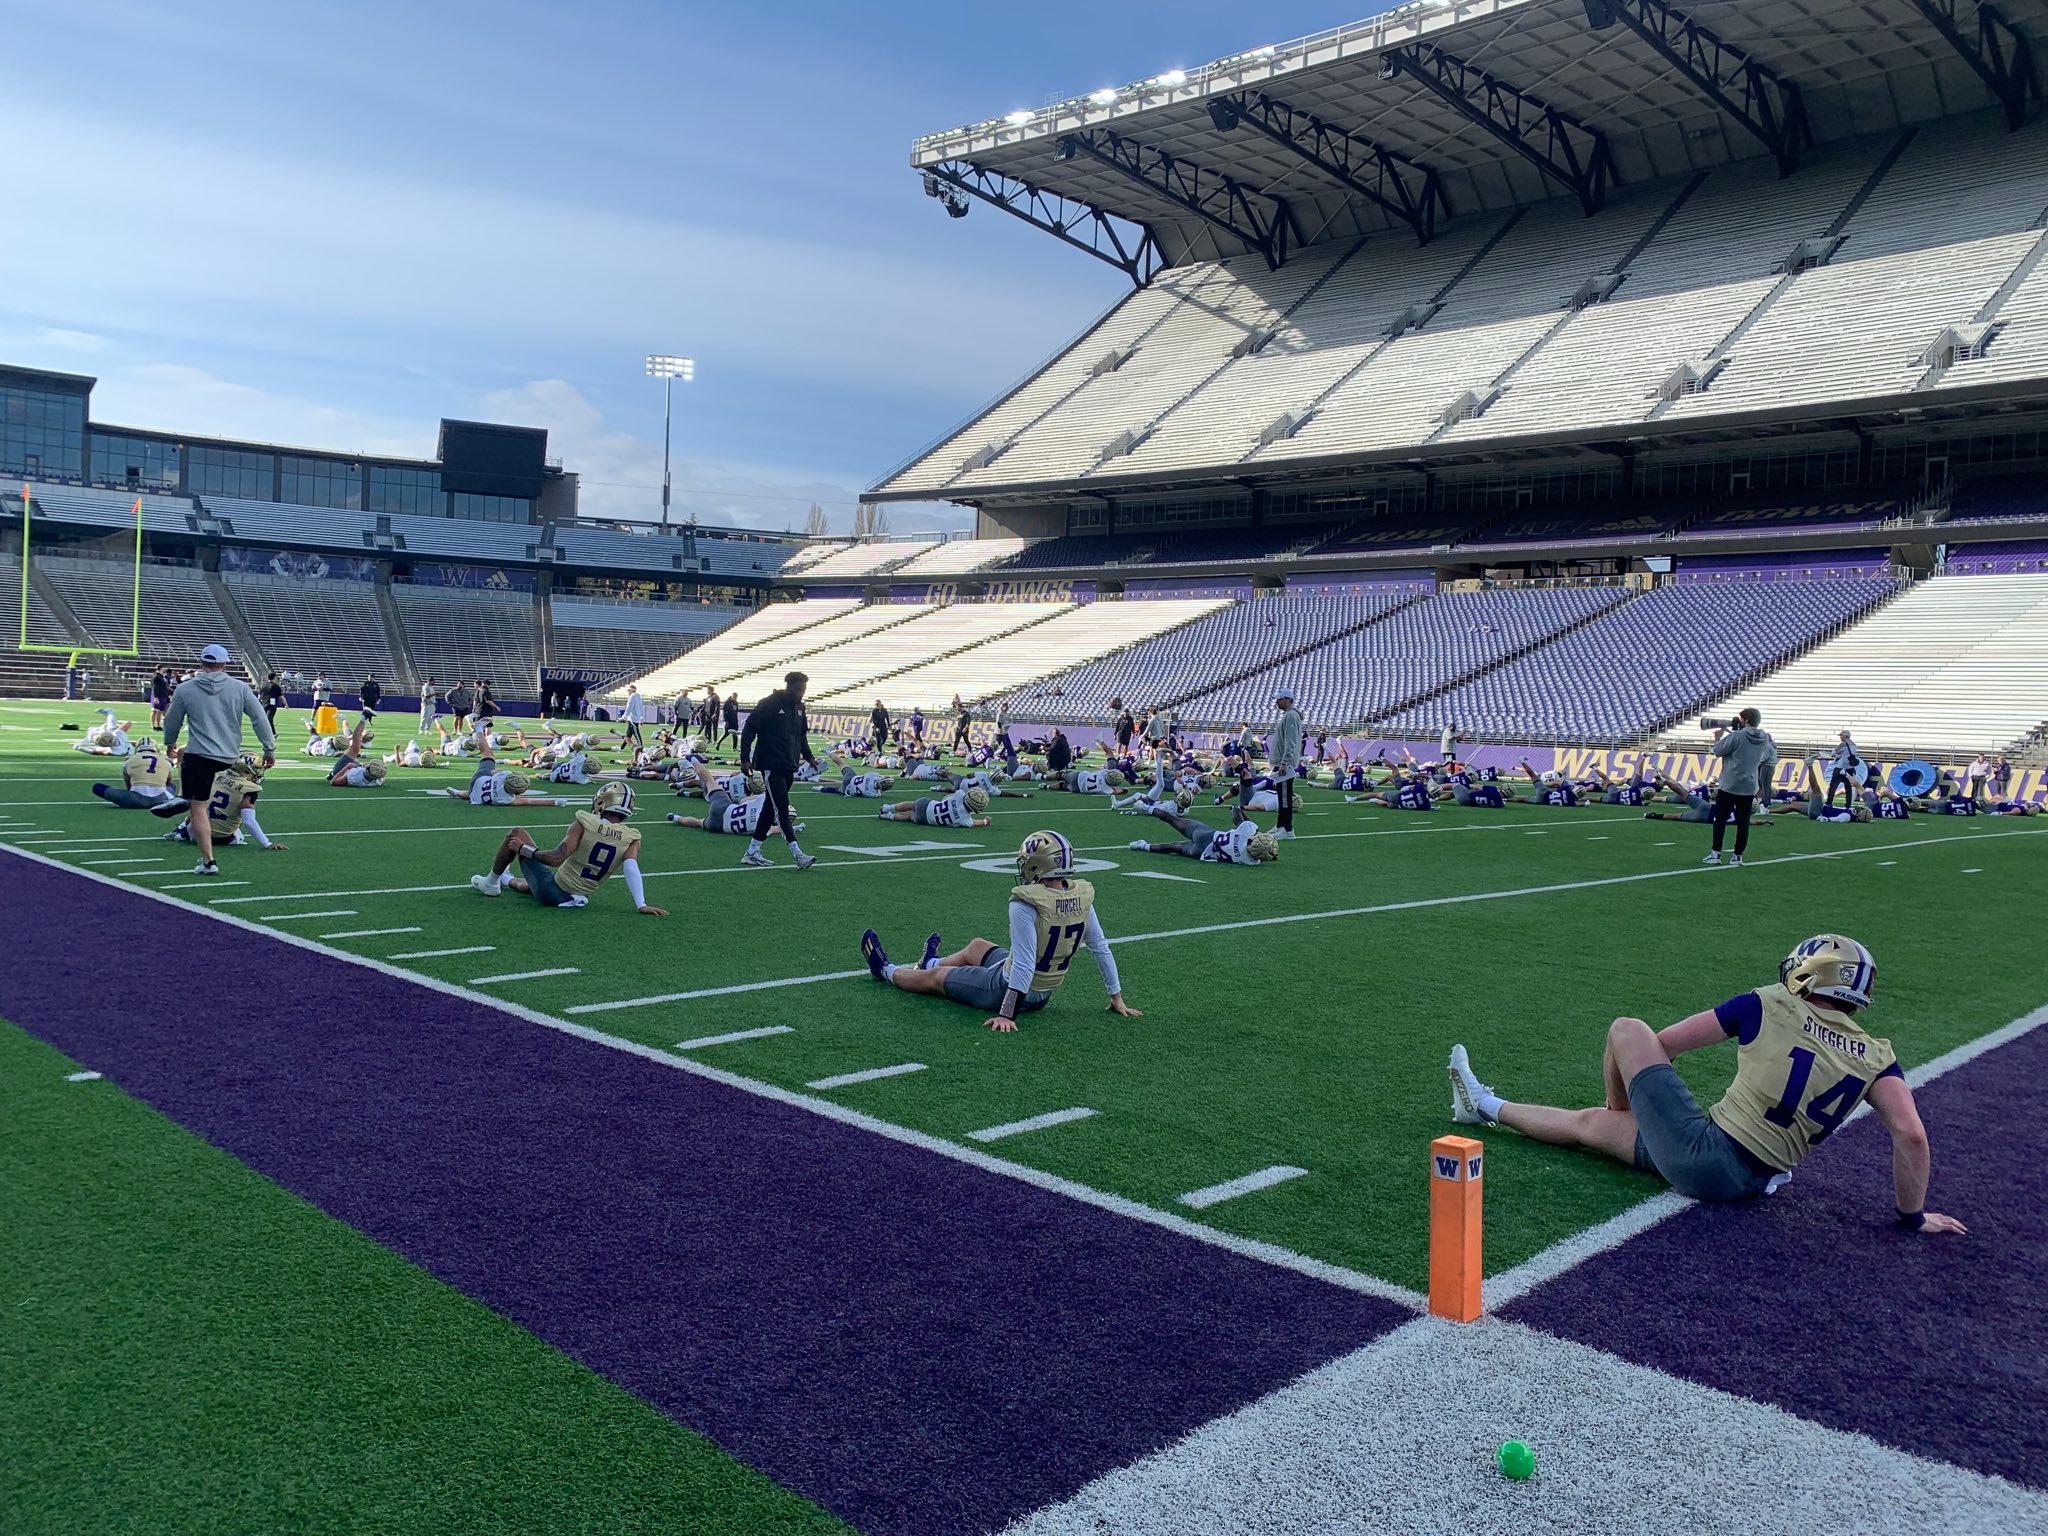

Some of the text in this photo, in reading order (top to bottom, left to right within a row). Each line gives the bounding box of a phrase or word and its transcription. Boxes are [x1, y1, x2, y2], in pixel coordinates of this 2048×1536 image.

[439, 565, 470, 587] W
[925, 580, 1073, 604] GO DAWGS
[546, 669, 577, 681] BOW
[142, 755, 158, 774] 7
[1553, 747, 1840, 794] WASHINON
[480, 779, 493, 805] 80
[1086, 774, 1098, 791] 71
[208, 790, 230, 820] 2
[934, 800, 952, 826] 25
[1881, 802, 1895, 818] 53
[730, 803, 748, 834] 82
[605, 827, 623, 841] DAVIS
[1025, 838, 1043, 854] W
[580, 841, 617, 881] 9
[1055, 897, 1082, 913] PURCELL
[1035, 921, 1085, 972] 17
[1803, 1015, 1866, 1060] STIEGELER
[1763, 1046, 1867, 1145] 14
[1435, 1156, 1459, 1178] W
[1468, 1157, 1482, 1178] W
